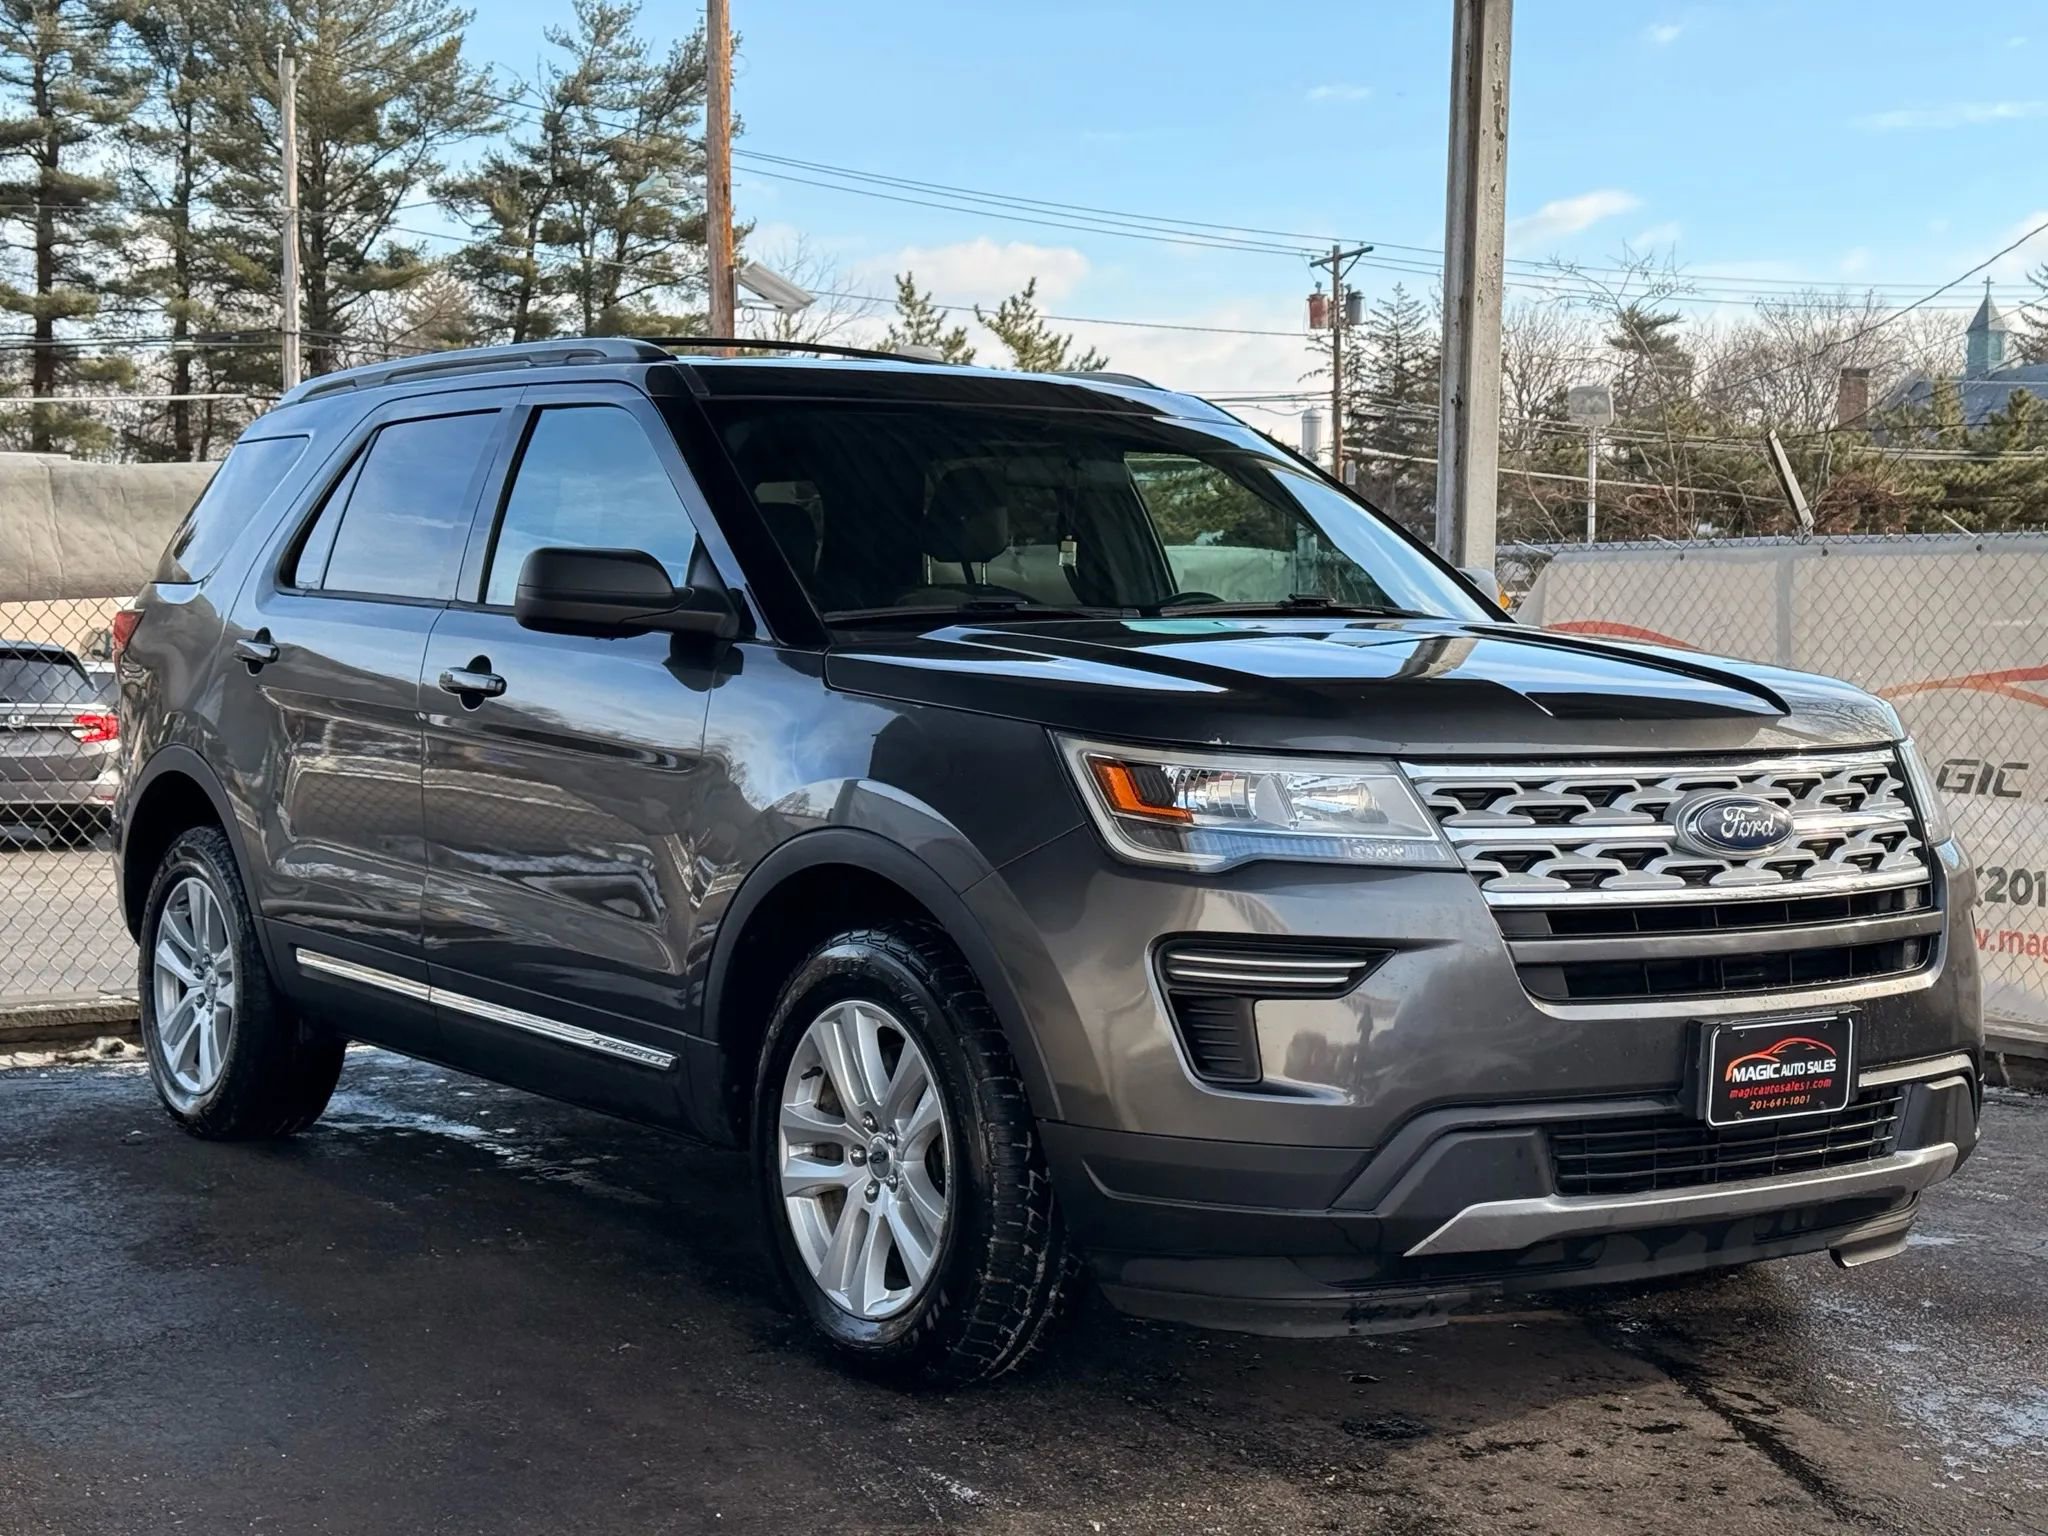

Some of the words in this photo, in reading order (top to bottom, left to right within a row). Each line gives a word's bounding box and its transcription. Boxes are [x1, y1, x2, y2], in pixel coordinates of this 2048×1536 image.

[1721, 806, 1777, 838] Ford
[1732, 1063, 1780, 1082] MAGIC
[1780, 1064, 1805, 1077] AUTO
[1807, 1059, 1836, 1074] SALES
[1749, 1095, 1810, 1110] 201-641-1001
